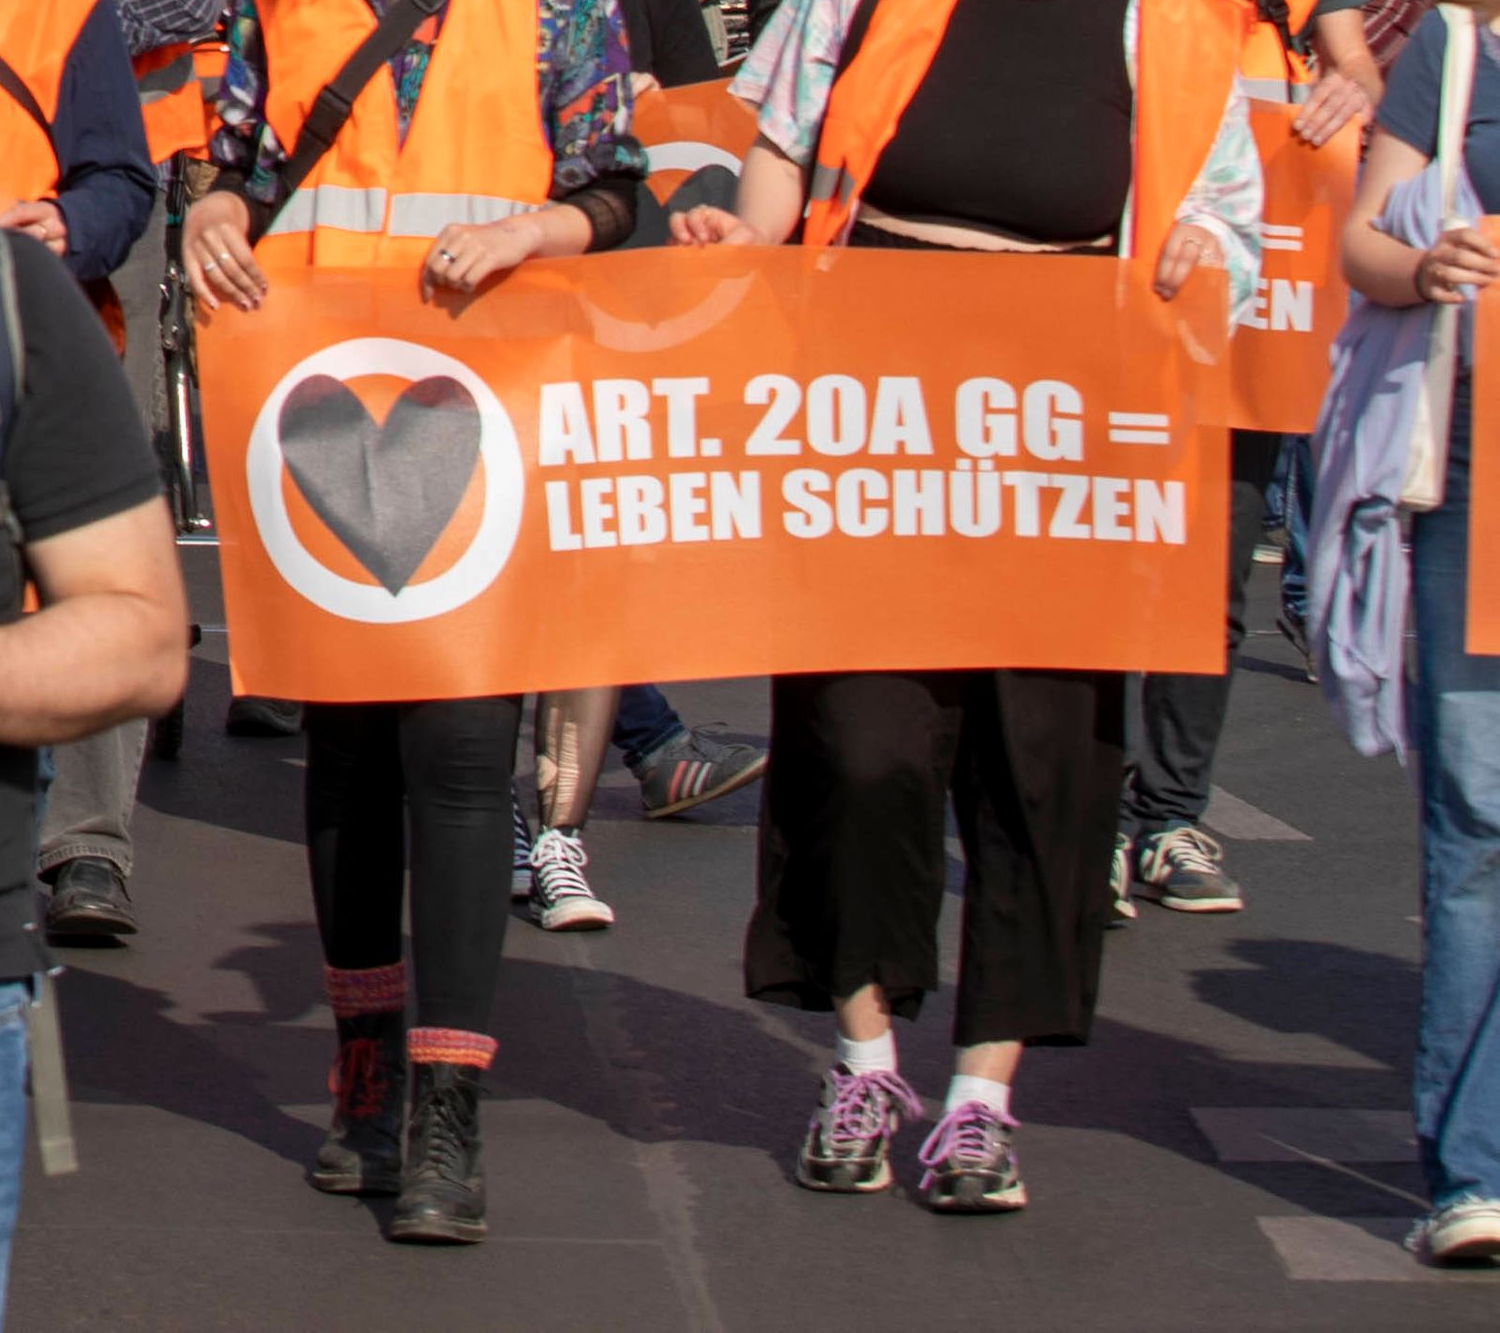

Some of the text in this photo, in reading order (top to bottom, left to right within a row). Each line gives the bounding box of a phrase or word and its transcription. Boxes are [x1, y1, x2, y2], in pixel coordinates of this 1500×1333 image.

[538, 373, 1170, 467] ART. 20A GG =
[544, 459, 1187, 552] LEBEN SCHÜTZEN
